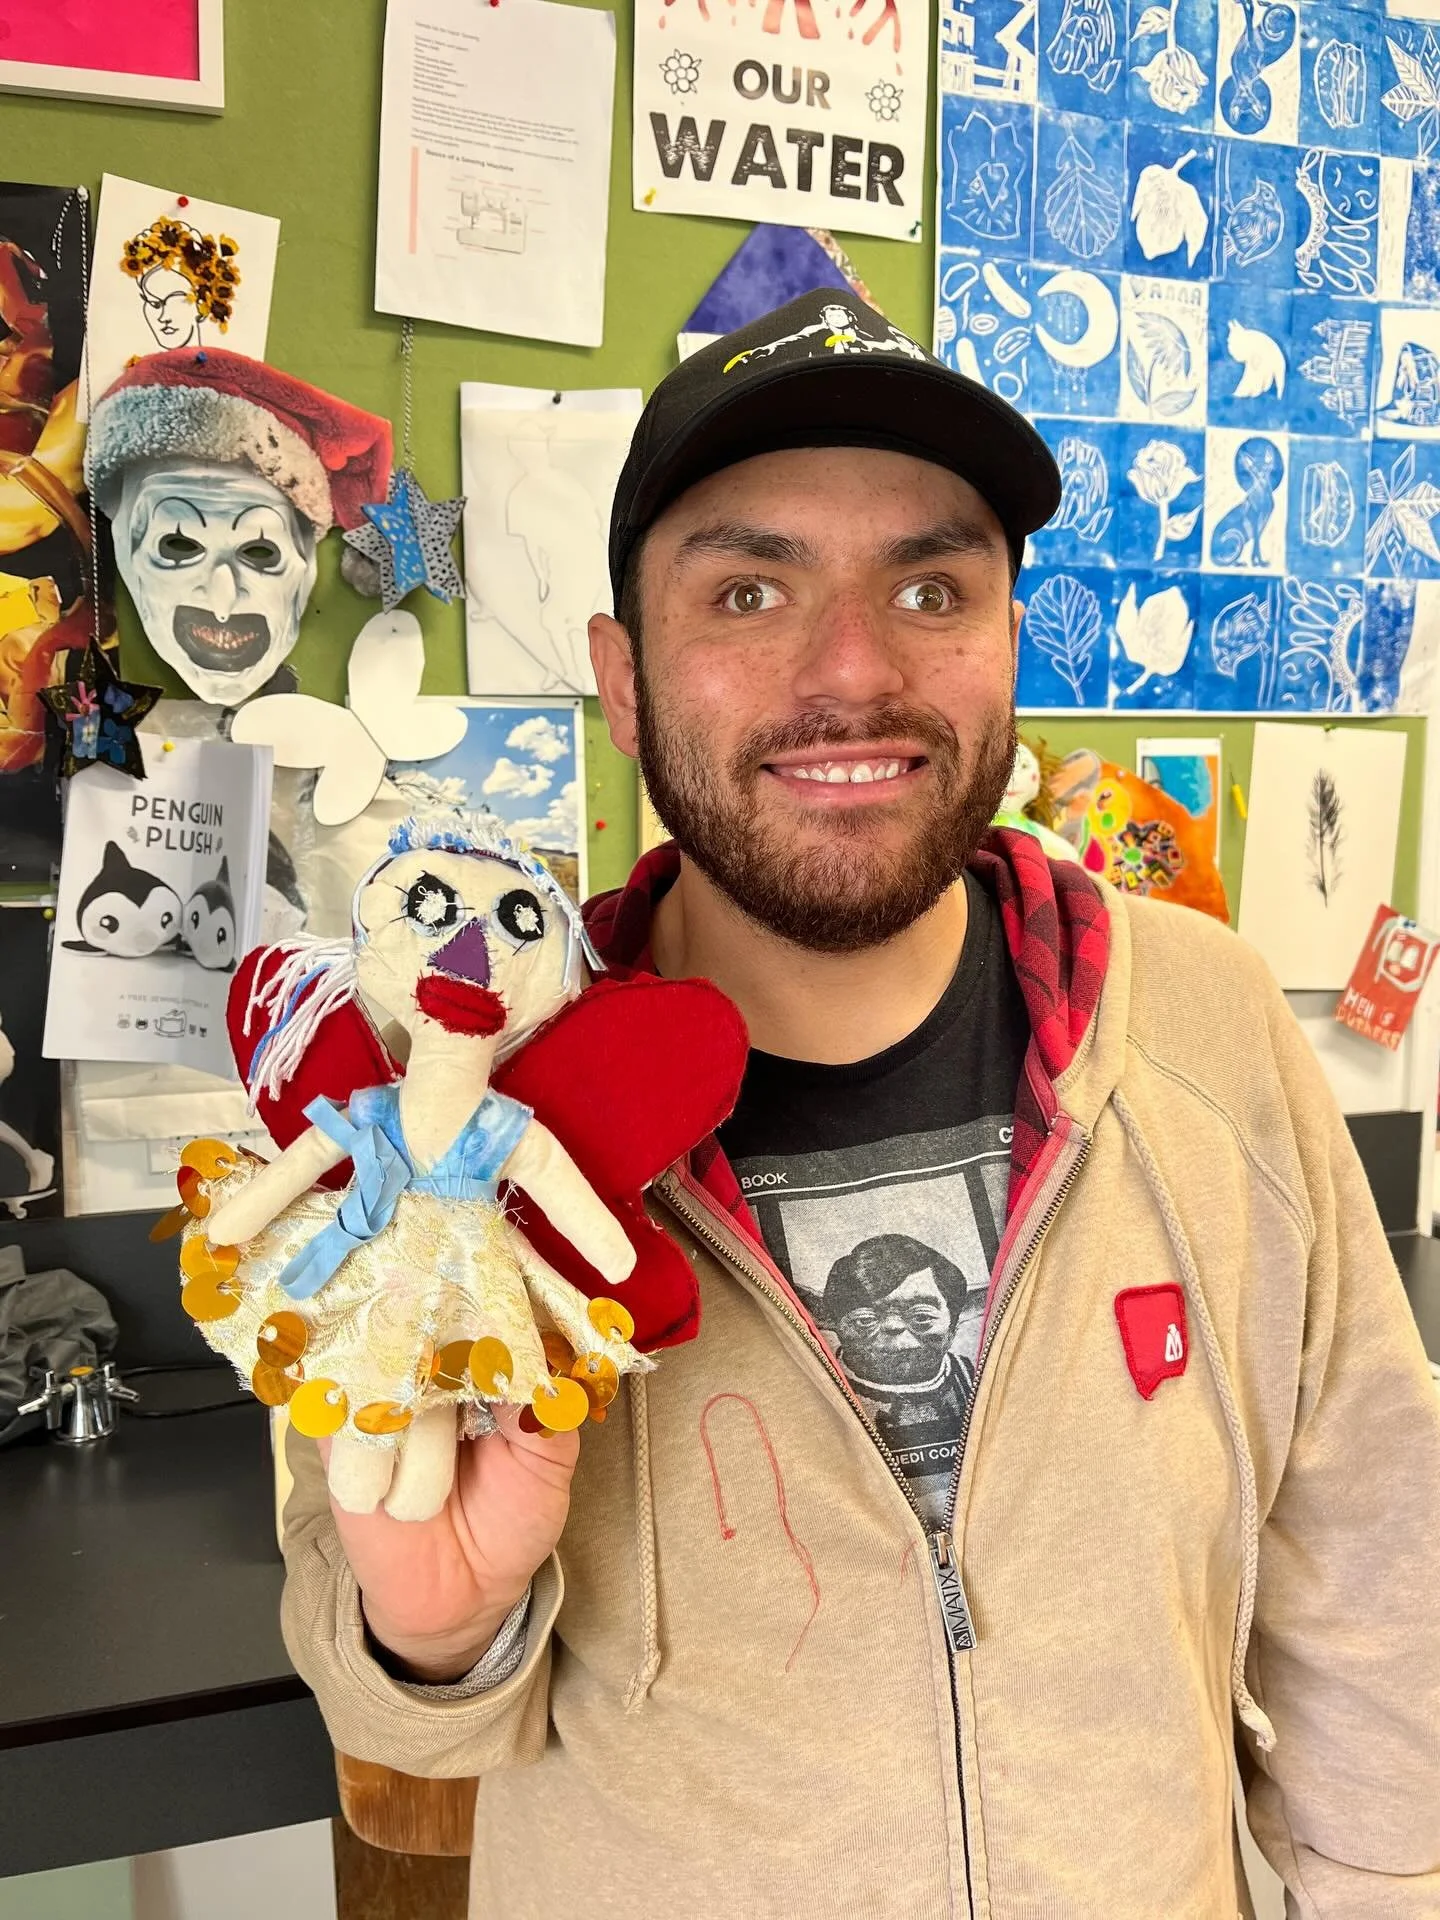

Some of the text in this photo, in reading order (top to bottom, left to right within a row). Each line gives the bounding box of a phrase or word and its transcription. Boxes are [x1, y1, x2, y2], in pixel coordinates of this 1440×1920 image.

[733, 59, 831, 109] OUR
[649, 112, 905, 207] WATER
[131, 795, 223, 827] PENGUIN
[146, 826, 212, 854] PLUSH
[741, 1172, 788, 1189] BOOK
[894, 1451, 924, 1465] JEDI
[938, 1570, 969, 1632] MATIX
